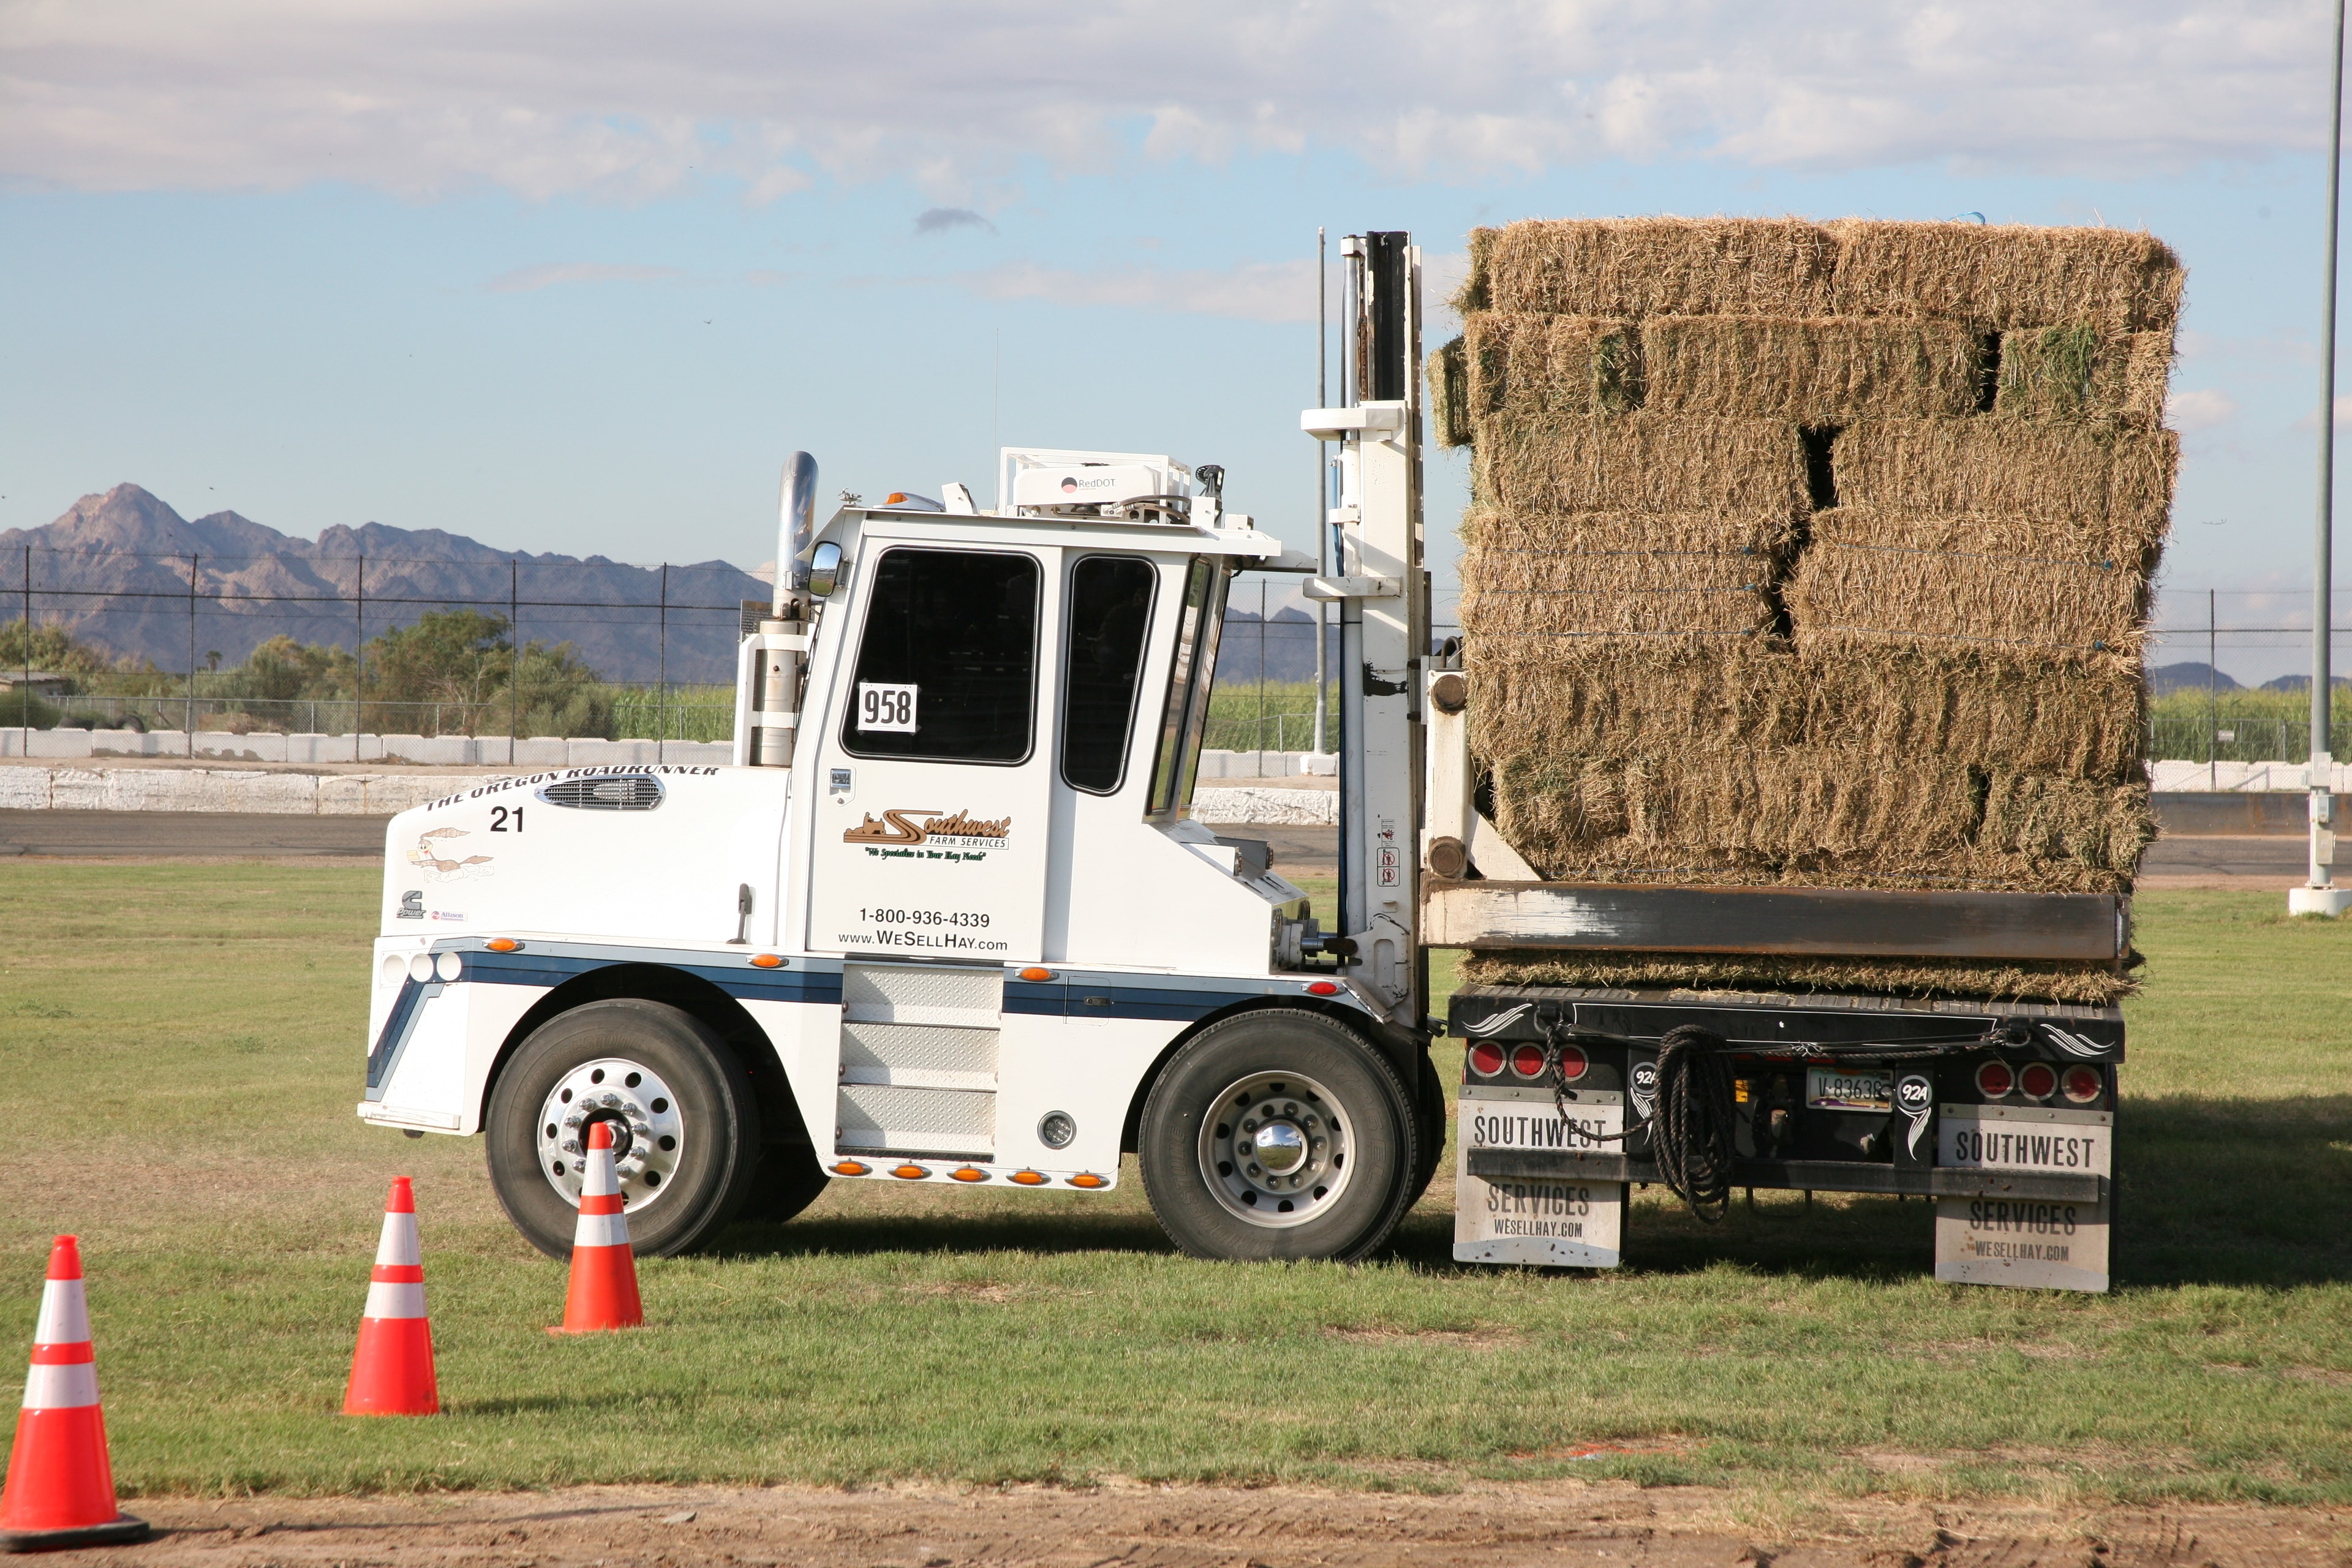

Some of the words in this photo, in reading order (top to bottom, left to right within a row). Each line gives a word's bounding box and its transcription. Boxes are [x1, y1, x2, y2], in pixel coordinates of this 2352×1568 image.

[1079, 478, 1115, 488] RedDOT
[864, 690, 911, 725] 958
[427, 791, 467, 812] THE
[470, 771, 560, 799] OREGON
[566, 765, 720, 779] ROADRUNNER
[490, 805, 524, 833] 21
[882, 809, 1011, 845] Southwest
[880, 848, 915, 860] Specialize
[926, 850, 943, 859] Your
[945, 851, 961, 864] Hay
[929, 836, 956, 846] FARM
[960, 837, 1006, 848] SERVICES
[859, 908, 990, 928] 1-800-936-4339
[1902, 1084, 1929, 1101] 92A
[1474, 1115, 1607, 1149] SOUTHWEST
[1956, 1131, 2095, 1168] SOUTHWEST
[1487, 1182, 1591, 1216] SERVICES
[1493, 1218, 1583, 1238] WESELLHAY.COM
[1969, 1200, 2077, 1236] SERVICES
[1975, 1240, 2070, 1262] WESELLHAY.COM
